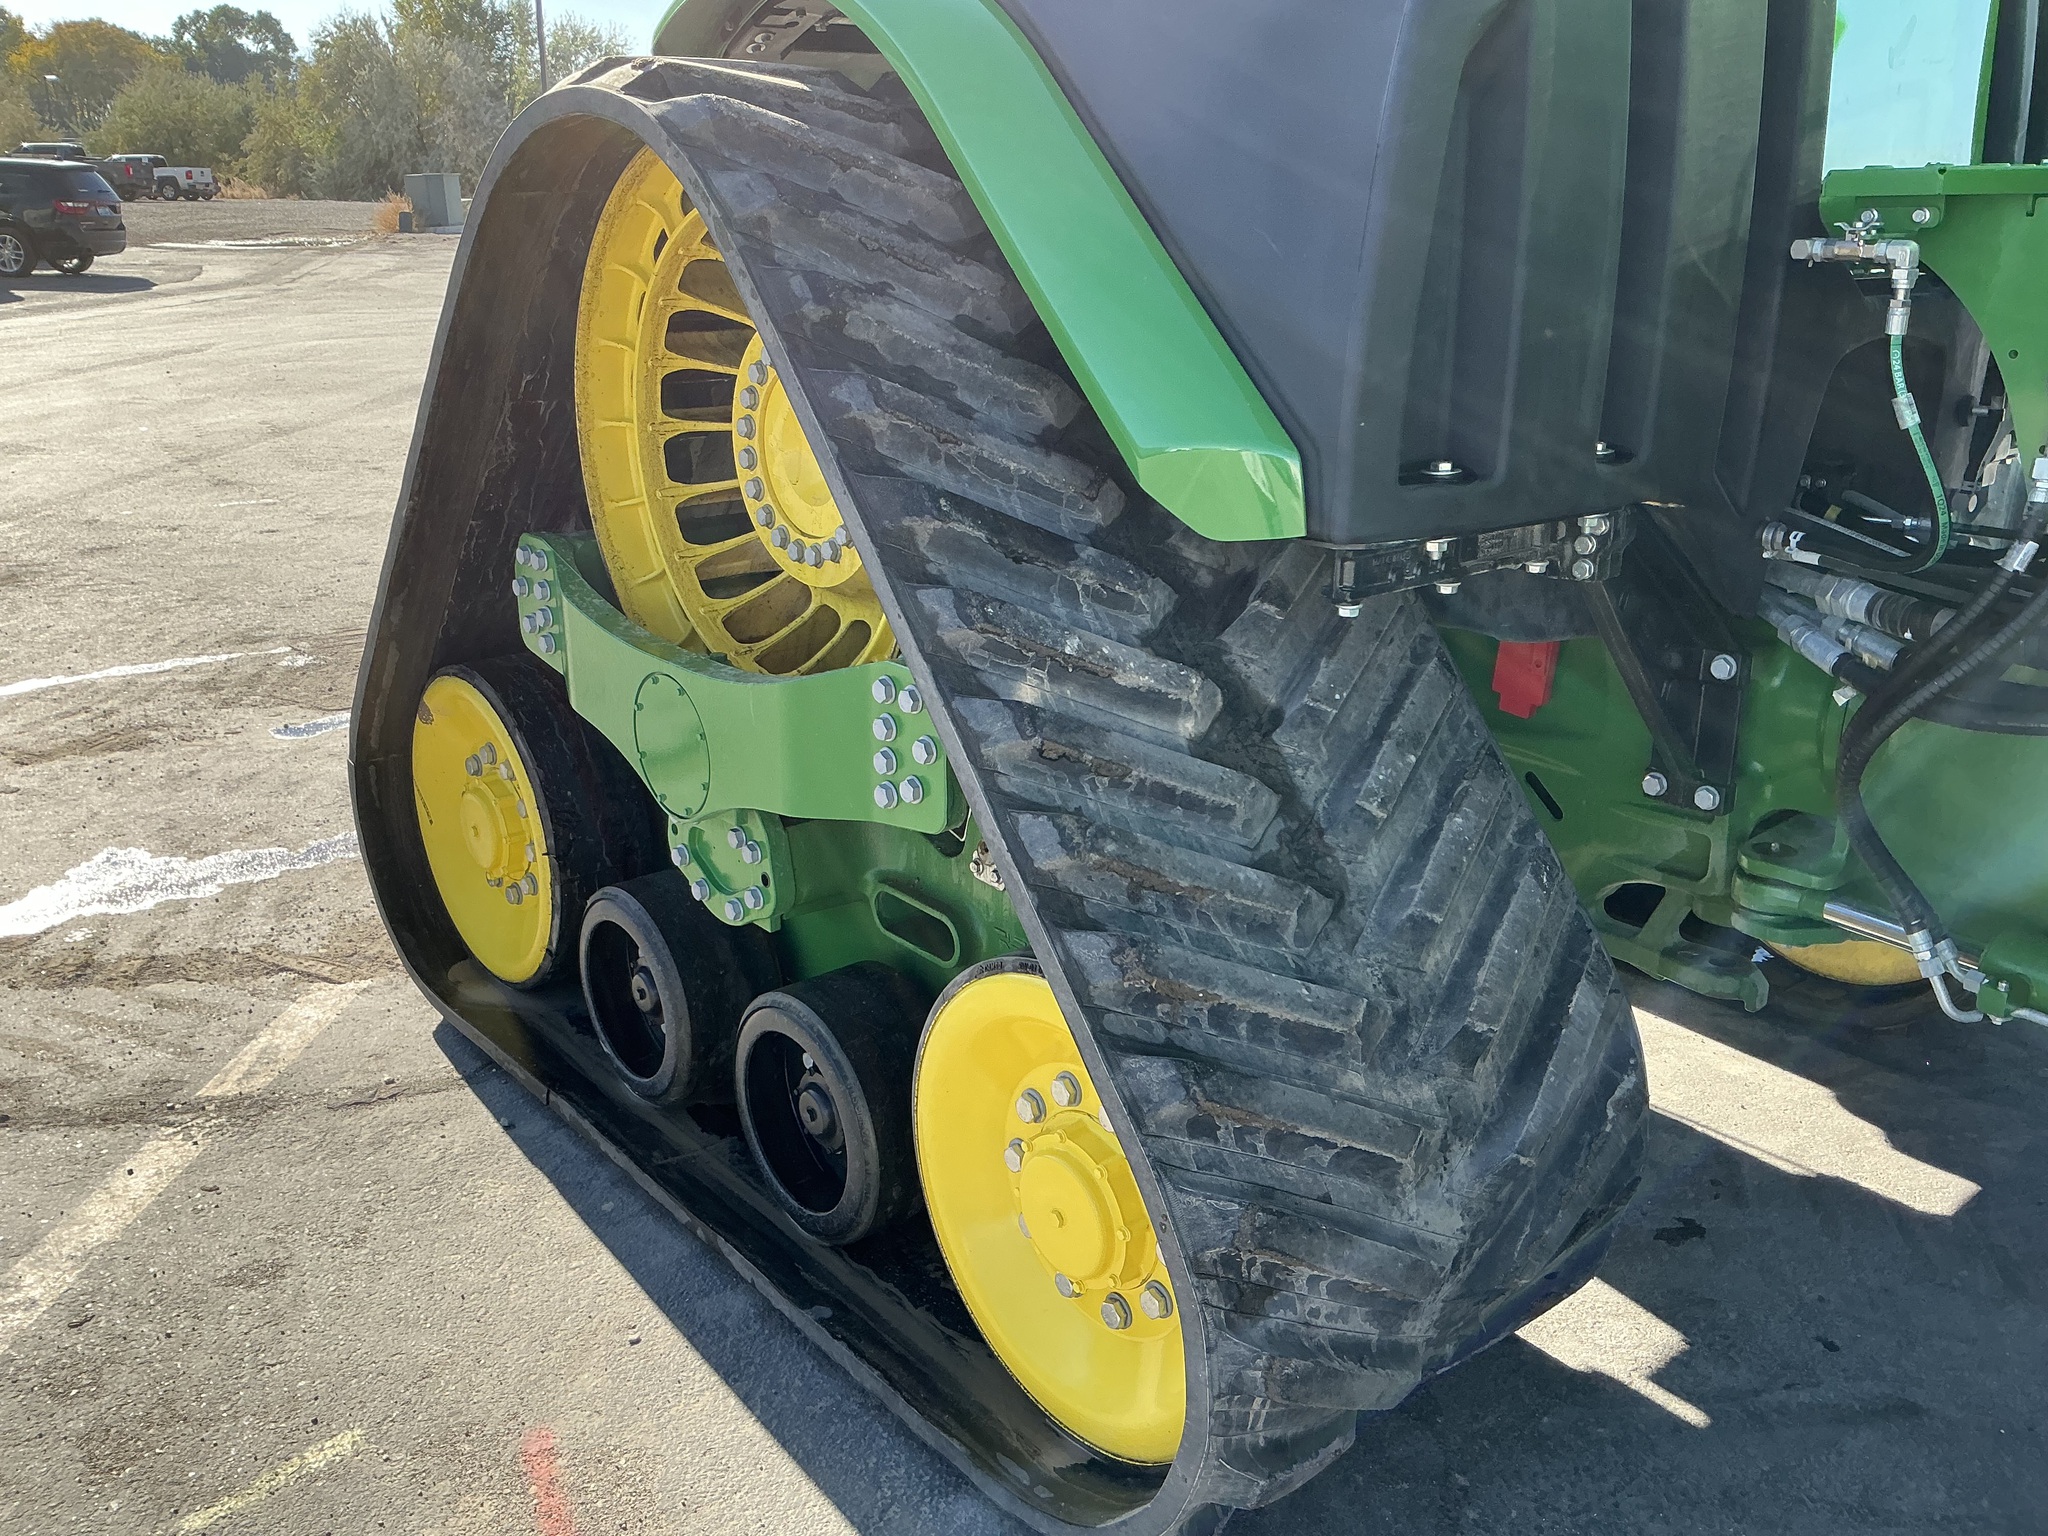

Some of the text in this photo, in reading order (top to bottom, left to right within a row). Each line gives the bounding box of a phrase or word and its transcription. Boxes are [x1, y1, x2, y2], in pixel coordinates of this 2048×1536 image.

[1892, 360, 1901, 370] 24
[1894, 372, 1905, 390] BAR
[1936, 494, 1946, 516] 1Q24
